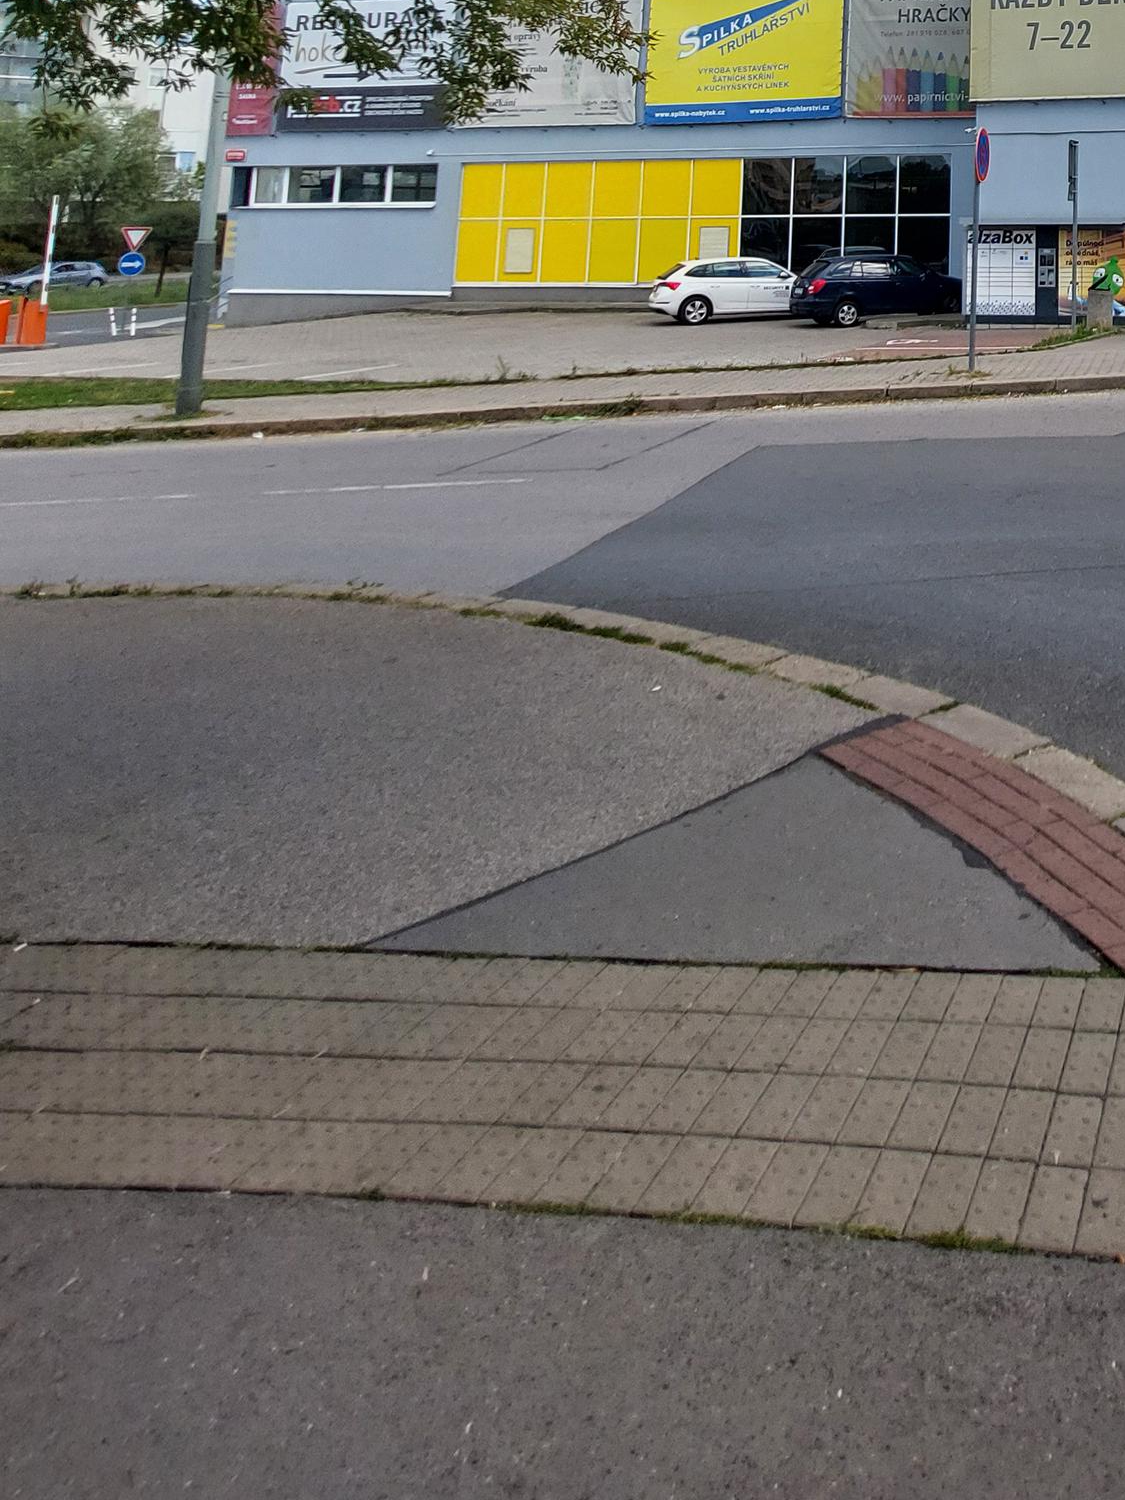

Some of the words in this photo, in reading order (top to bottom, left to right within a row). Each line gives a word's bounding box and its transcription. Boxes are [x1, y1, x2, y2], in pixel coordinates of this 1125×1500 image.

[677, 13, 753, 60] SPILKA
[718, 0, 811, 56] TRUHLÁŘSTVÍ
[765, 81, 790, 89] LINEK
